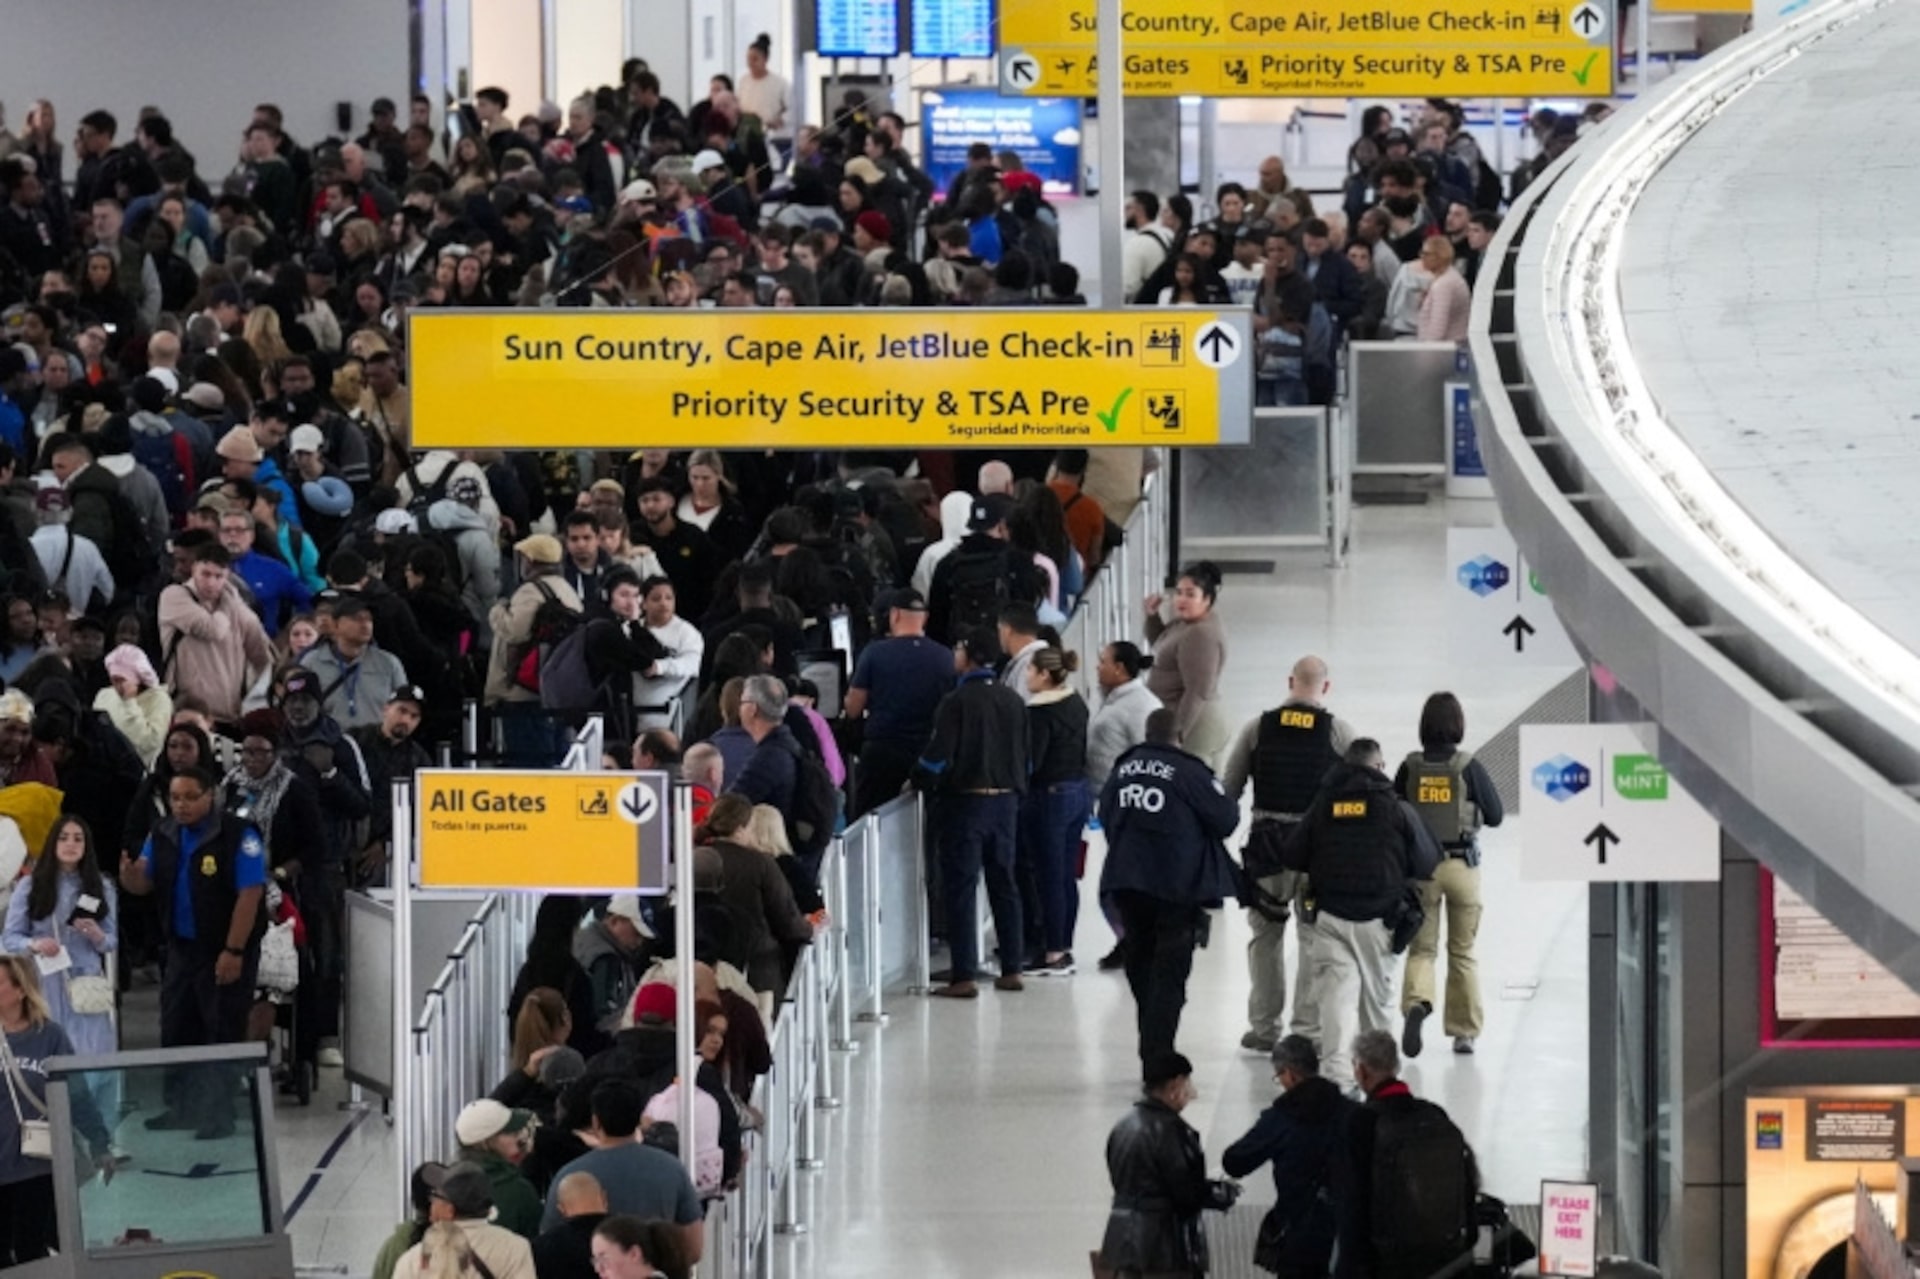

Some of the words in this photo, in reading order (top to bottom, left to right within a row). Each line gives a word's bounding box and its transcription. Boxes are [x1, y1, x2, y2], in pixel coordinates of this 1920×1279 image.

[1069, 11, 1097, 32] Su
[1121, 11, 1220, 37] Country,
[1229, 11, 1287, 37] Cape
[1293, 11, 1331, 33] Air,
[1337, 11, 1420, 32] JetBlue
[1427, 10, 1526, 32] Check-in
[1124, 54, 1190, 75] Gates
[1261, 53, 1345, 80] Priority
[1353, 53, 1446, 79] Security
[1453, 54, 1470, 74] &
[1477, 54, 1523, 74] TSA
[1530, 54, 1566, 74] Pre
[1134, 80, 1173, 91] puertas
[1260, 78, 1311, 91] Seguridad
[1314, 78, 1365, 90] Prioritaria
[504, 334, 563, 361] Sun
[575, 334, 711, 368] Country,
[726, 335, 803, 367] Cape
[813, 333, 865, 363] Air,
[876, 332, 989, 359] JetBlue
[1000, 330, 1133, 358] Check-in
[672, 390, 788, 424] Priority
[799, 390, 925, 423] Security
[936, 390, 958, 416] &
[968, 390, 1031, 416] TSA
[1041, 390, 1090, 416] Pre
[947, 423, 1019, 439] Seguridad
[1021, 423, 1091, 436] Prioritaria
[1280, 709, 1315, 729] ERO
[1117, 759, 1176, 781] POLICE
[1617, 774, 1664, 790] MINT
[429, 789, 464, 812] All
[471, 789, 546, 813] Gates
[1419, 786, 1451, 803] ERO
[1333, 801, 1366, 818] ERO
[431, 820, 463, 832] Todas
[465, 820, 482, 832] las
[484, 821, 528, 834] puertas
[1548, 1196, 1590, 1211] PLEASE
[1557, 1211, 1581, 1224] EXIT
[1554, 1226, 1583, 1239] HERE
